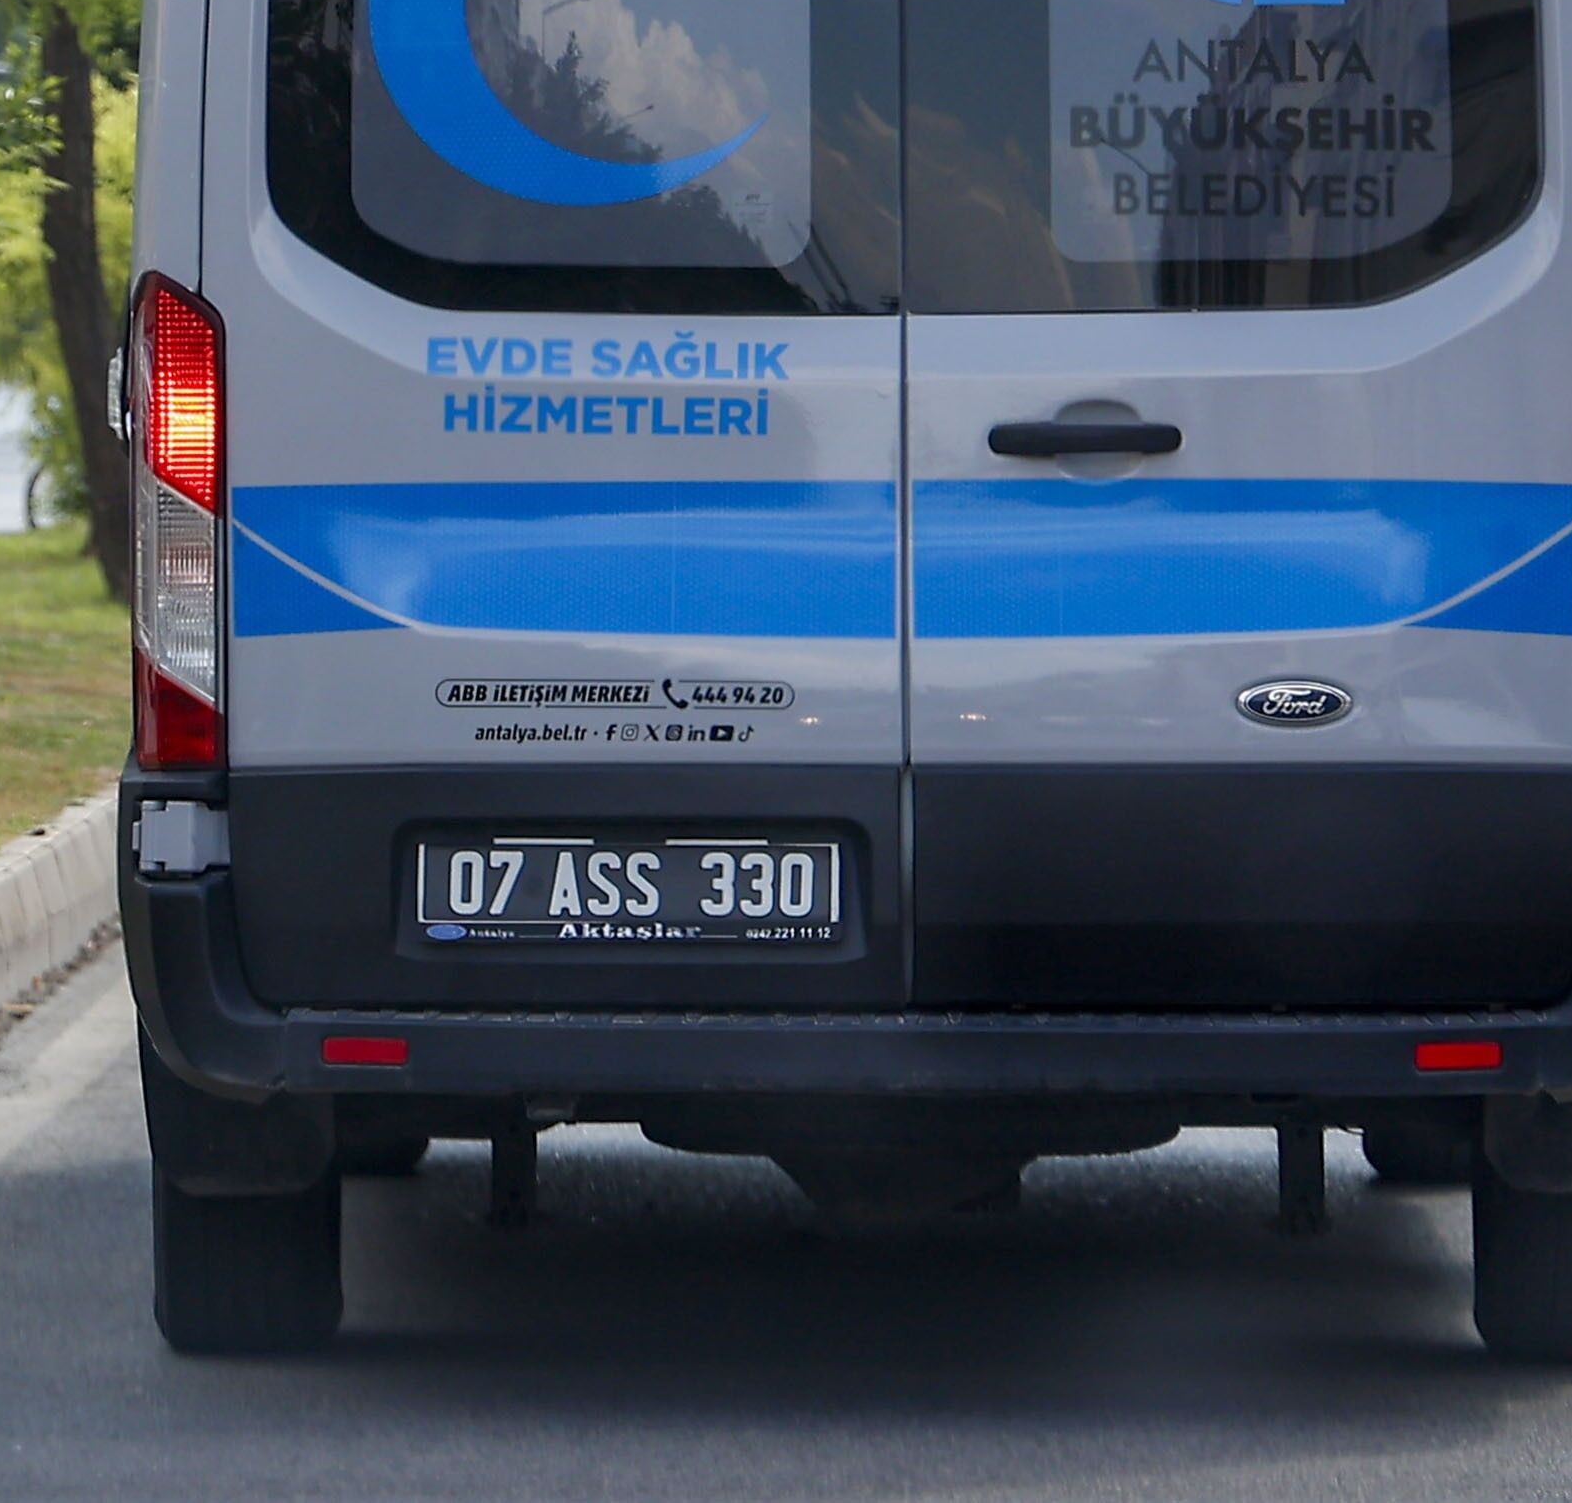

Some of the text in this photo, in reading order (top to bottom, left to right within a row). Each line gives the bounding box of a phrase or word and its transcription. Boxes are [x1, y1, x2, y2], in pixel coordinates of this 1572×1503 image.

[1133, 38, 1376, 83] ANTALYA
[1070, 93, 1436, 162] BÜYÜKŞEHİR
[1113, 162, 1396, 218] BELEDİYESİ
[427, 330, 790, 380] EVDE SAĞLIK
[444, 385, 769, 436] HİZMETLERİ
[447, 684, 487, 703] ABB
[691, 686, 730, 705] 444
[731, 686, 757, 705] 94
[758, 686, 784, 705] 20
[1262, 688, 1328, 715] Ford
[475, 723, 588, 744] antalya.bel.tr
[449, 850, 815, 918] 07 ASS 330
[468, 928, 515, 940] Antalya
[558, 922, 702, 940] Aktaşlar
